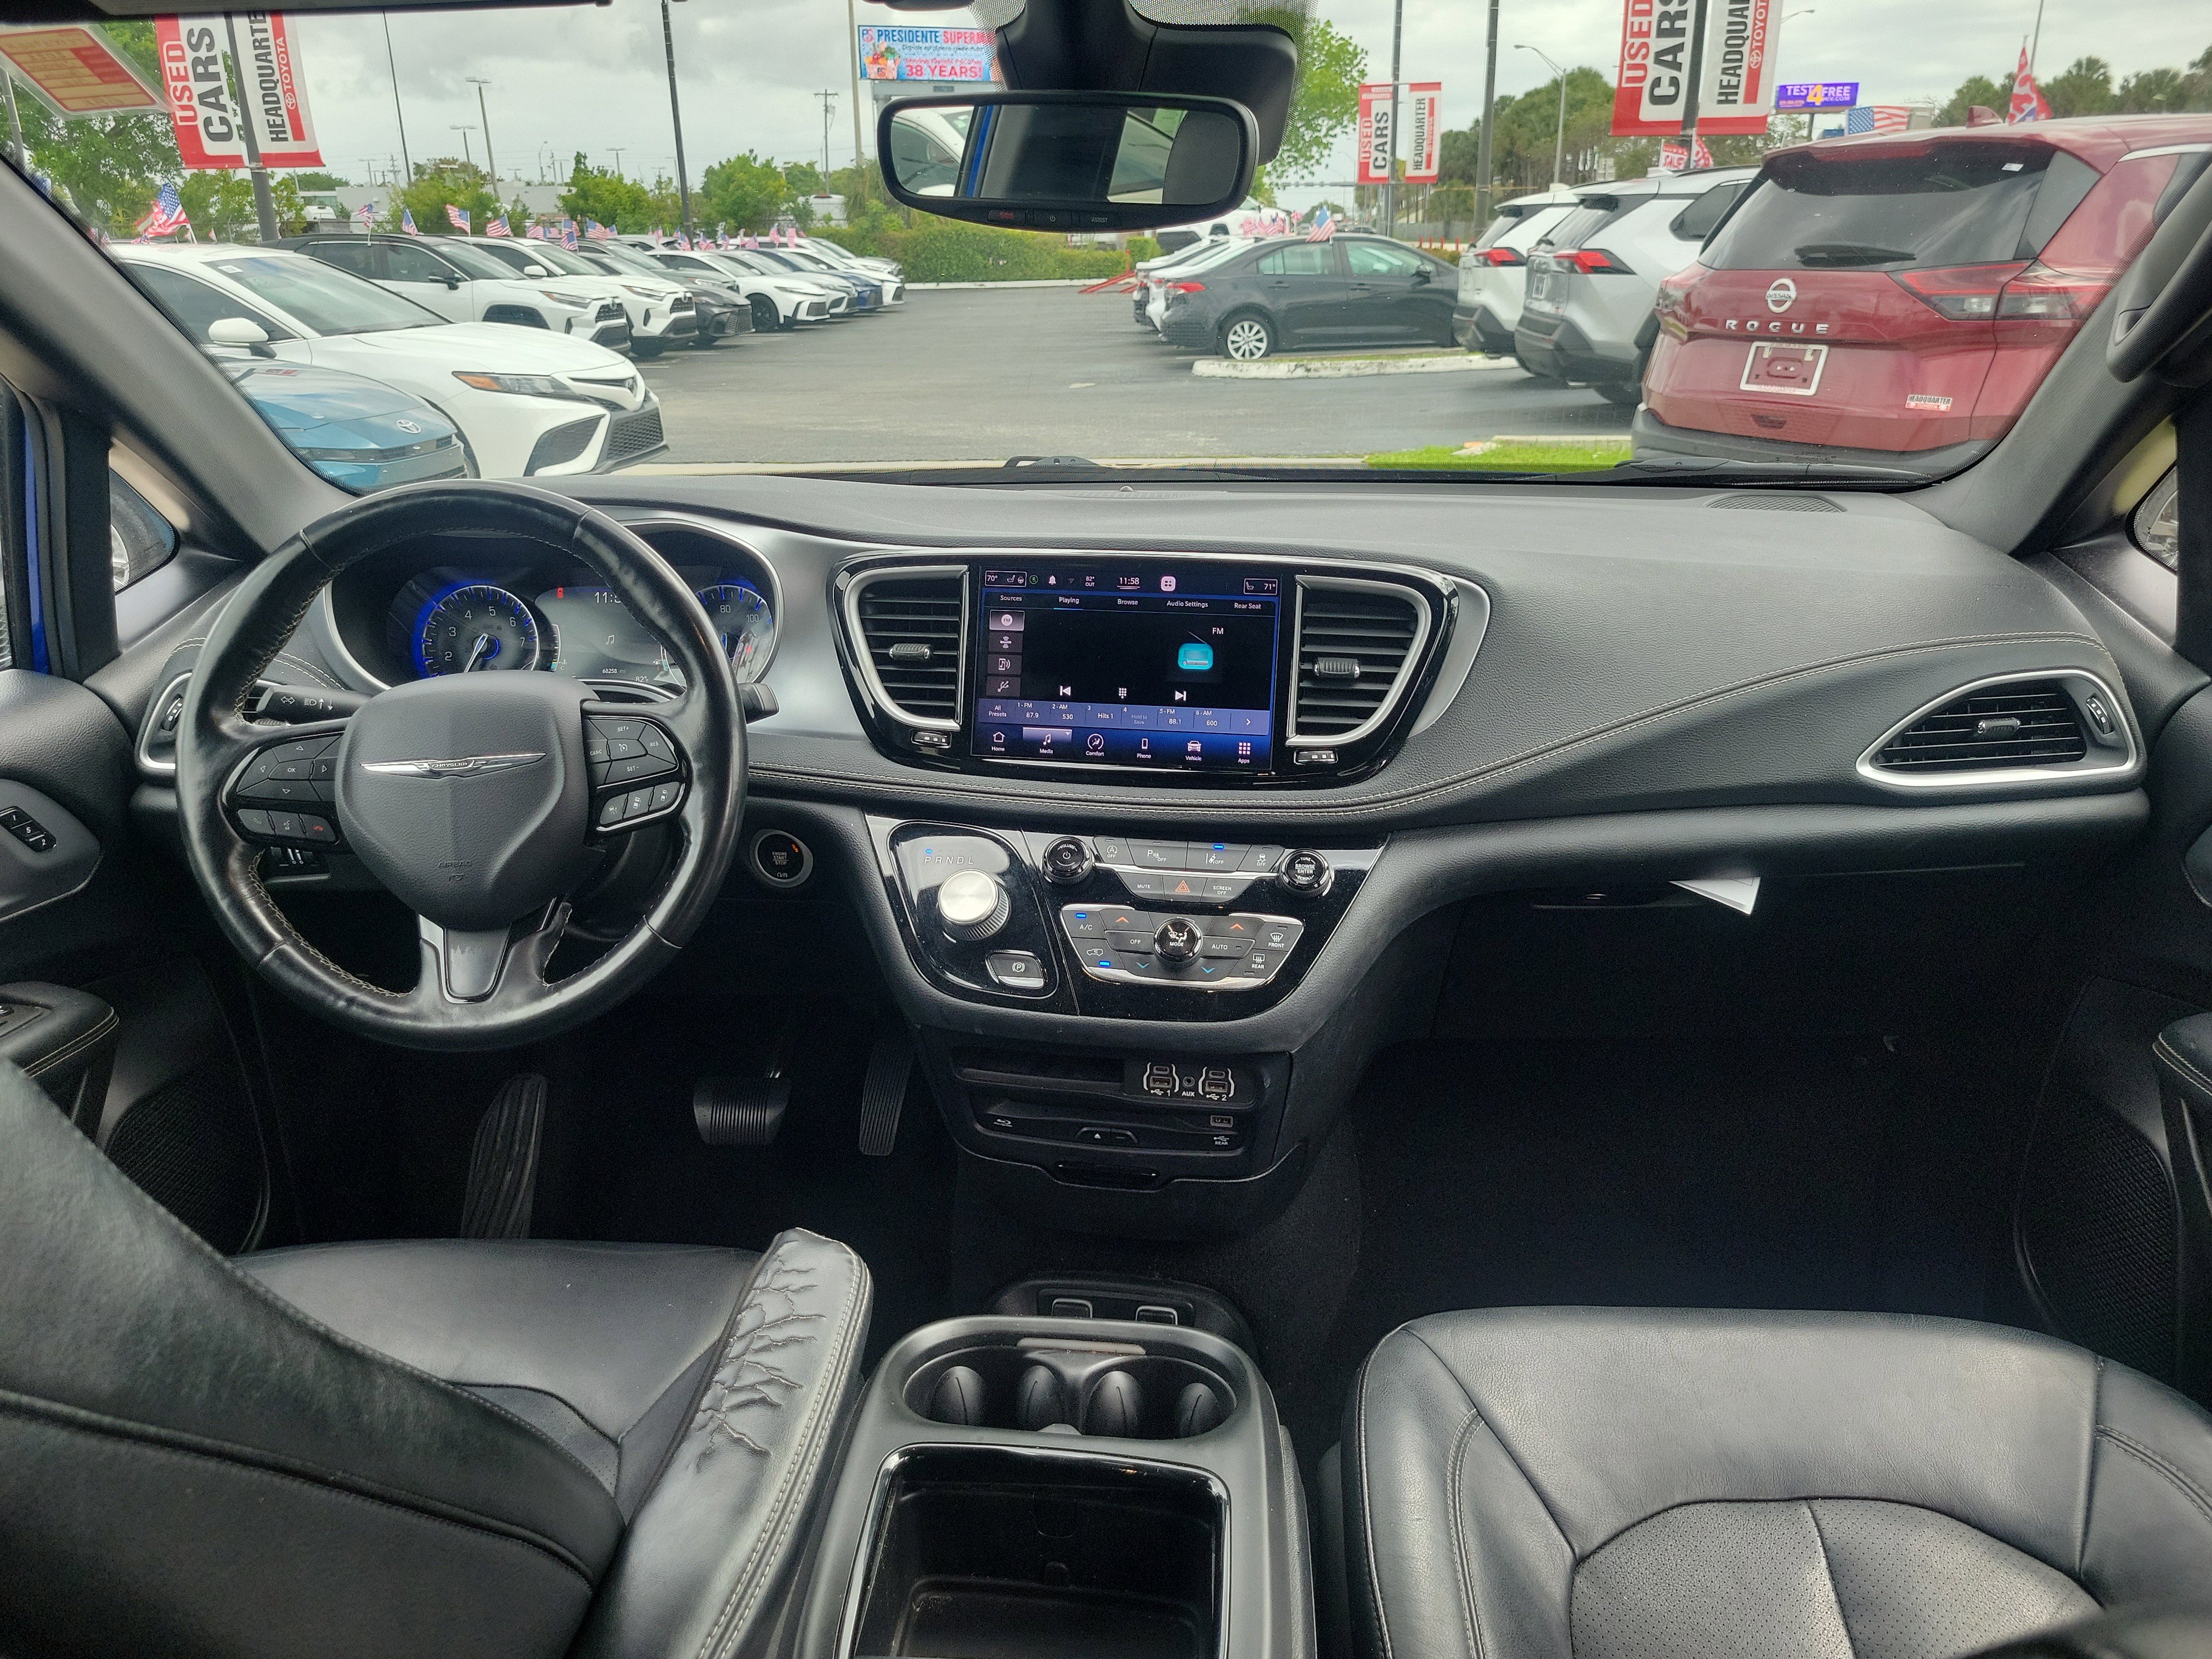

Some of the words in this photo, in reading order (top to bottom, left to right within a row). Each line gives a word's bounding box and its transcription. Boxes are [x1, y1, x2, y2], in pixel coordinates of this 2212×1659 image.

[1753, 0, 1768, 48] TOYOT
[878, 29, 940, 43] PRESIDENTE
[1623, 0, 1653, 85] USED
[1649, 0, 1688, 105] CAR
[276, 36, 292, 91] TOYOTA
[906, 65, 924, 77] 38
[929, 65, 983, 78] YEARS!
[164, 42, 198, 125] USED
[187, 27, 233, 142] CARS
[1786, 86, 1814, 96] TEST
[1806, 84, 1823, 105] 4
[1822, 86, 1852, 97] FREE
[1361, 119, 1372, 161] USED
[1374, 111, 1389, 170] CARS
[1413, 98, 1426, 170] HEADQUARTER
[1725, 319, 1830, 335] ROGUE
[1908, 395, 1951, 405] HEADQUARTER
[465, 610, 472, 620] 4
[489, 606, 496, 616] 5
[720, 605, 731, 613] 80
[510, 617, 516, 627] 6
[746, 614, 759, 623] 100
[449, 627, 456, 636] 3
[520, 637, 525, 647] 7
[445, 651, 452, 661] 2
[438, 860, 472, 868] AIRBAG
